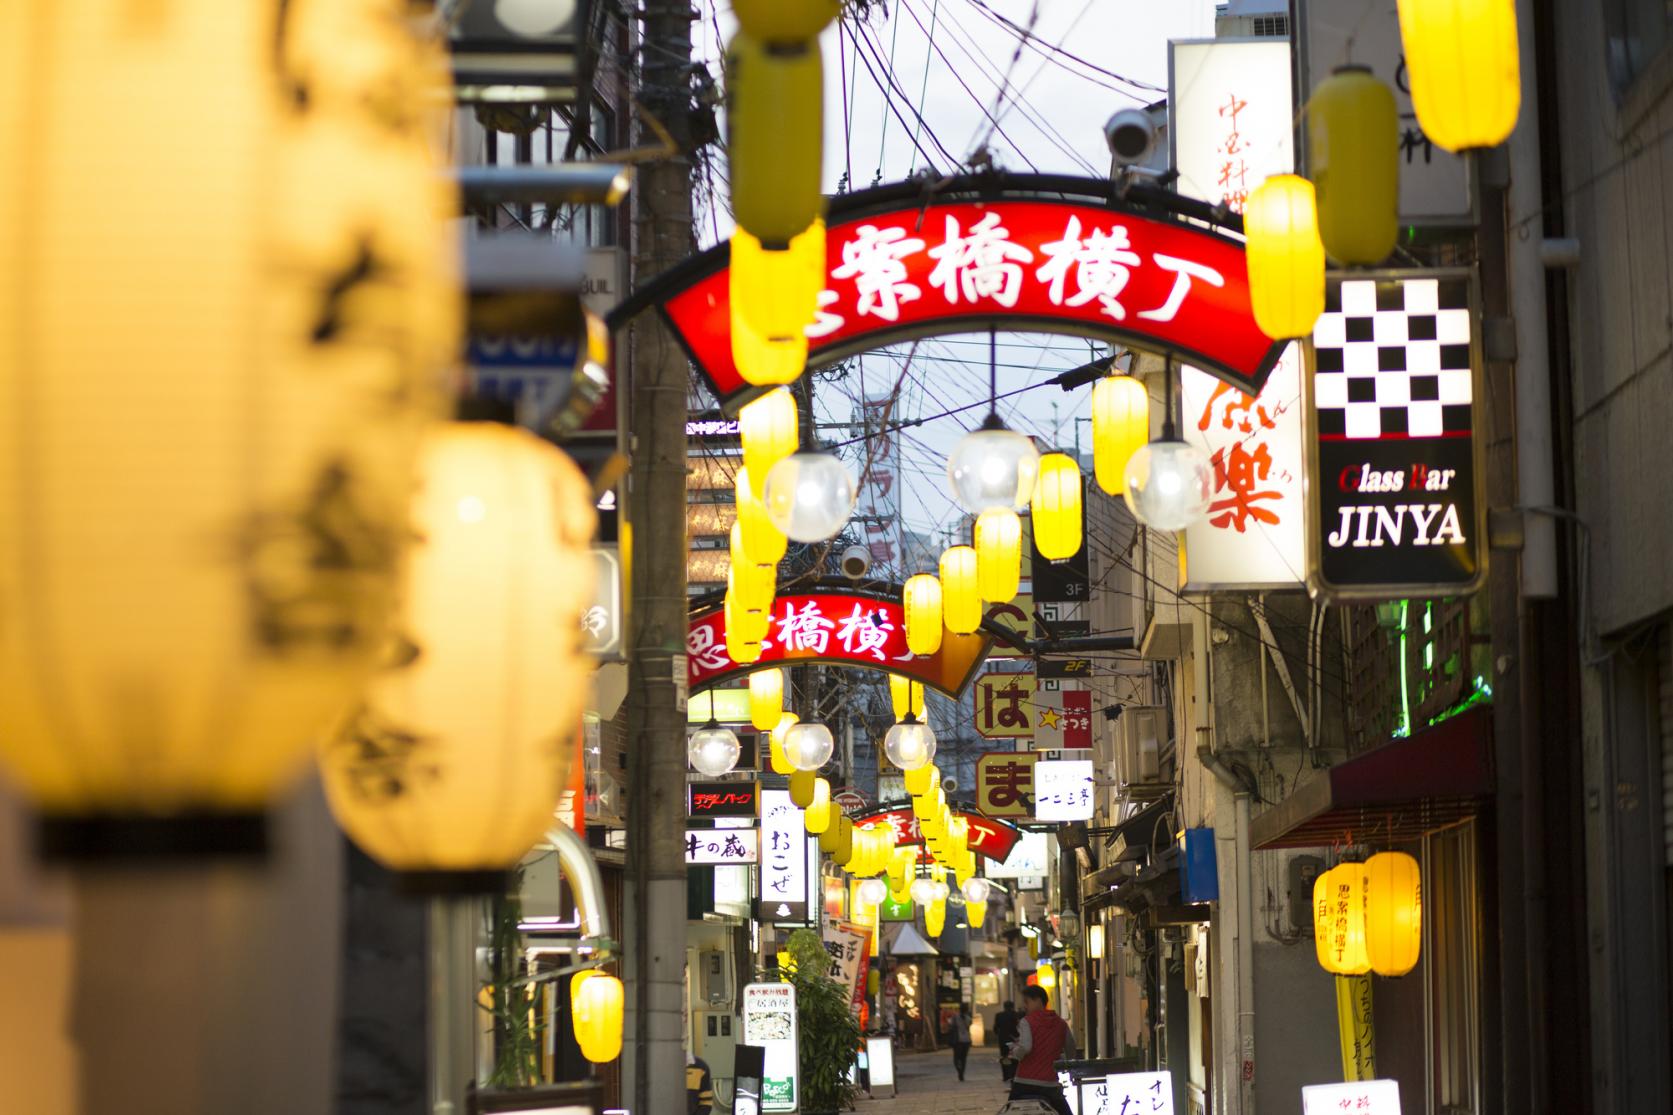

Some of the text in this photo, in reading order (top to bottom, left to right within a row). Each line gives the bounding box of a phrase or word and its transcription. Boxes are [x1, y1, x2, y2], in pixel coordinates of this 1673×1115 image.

[804, 211, 1225, 338] 案橋横丁
[1338, 462, 1456, 492] Glass Bar
[1328, 503, 1466, 548] JINYA
[1065, 584, 1084, 596] 3F
[687, 600, 913, 676] 思橋横
[1063, 660, 1087, 672] 2F
[770, 831, 793, 893] おこぜ
